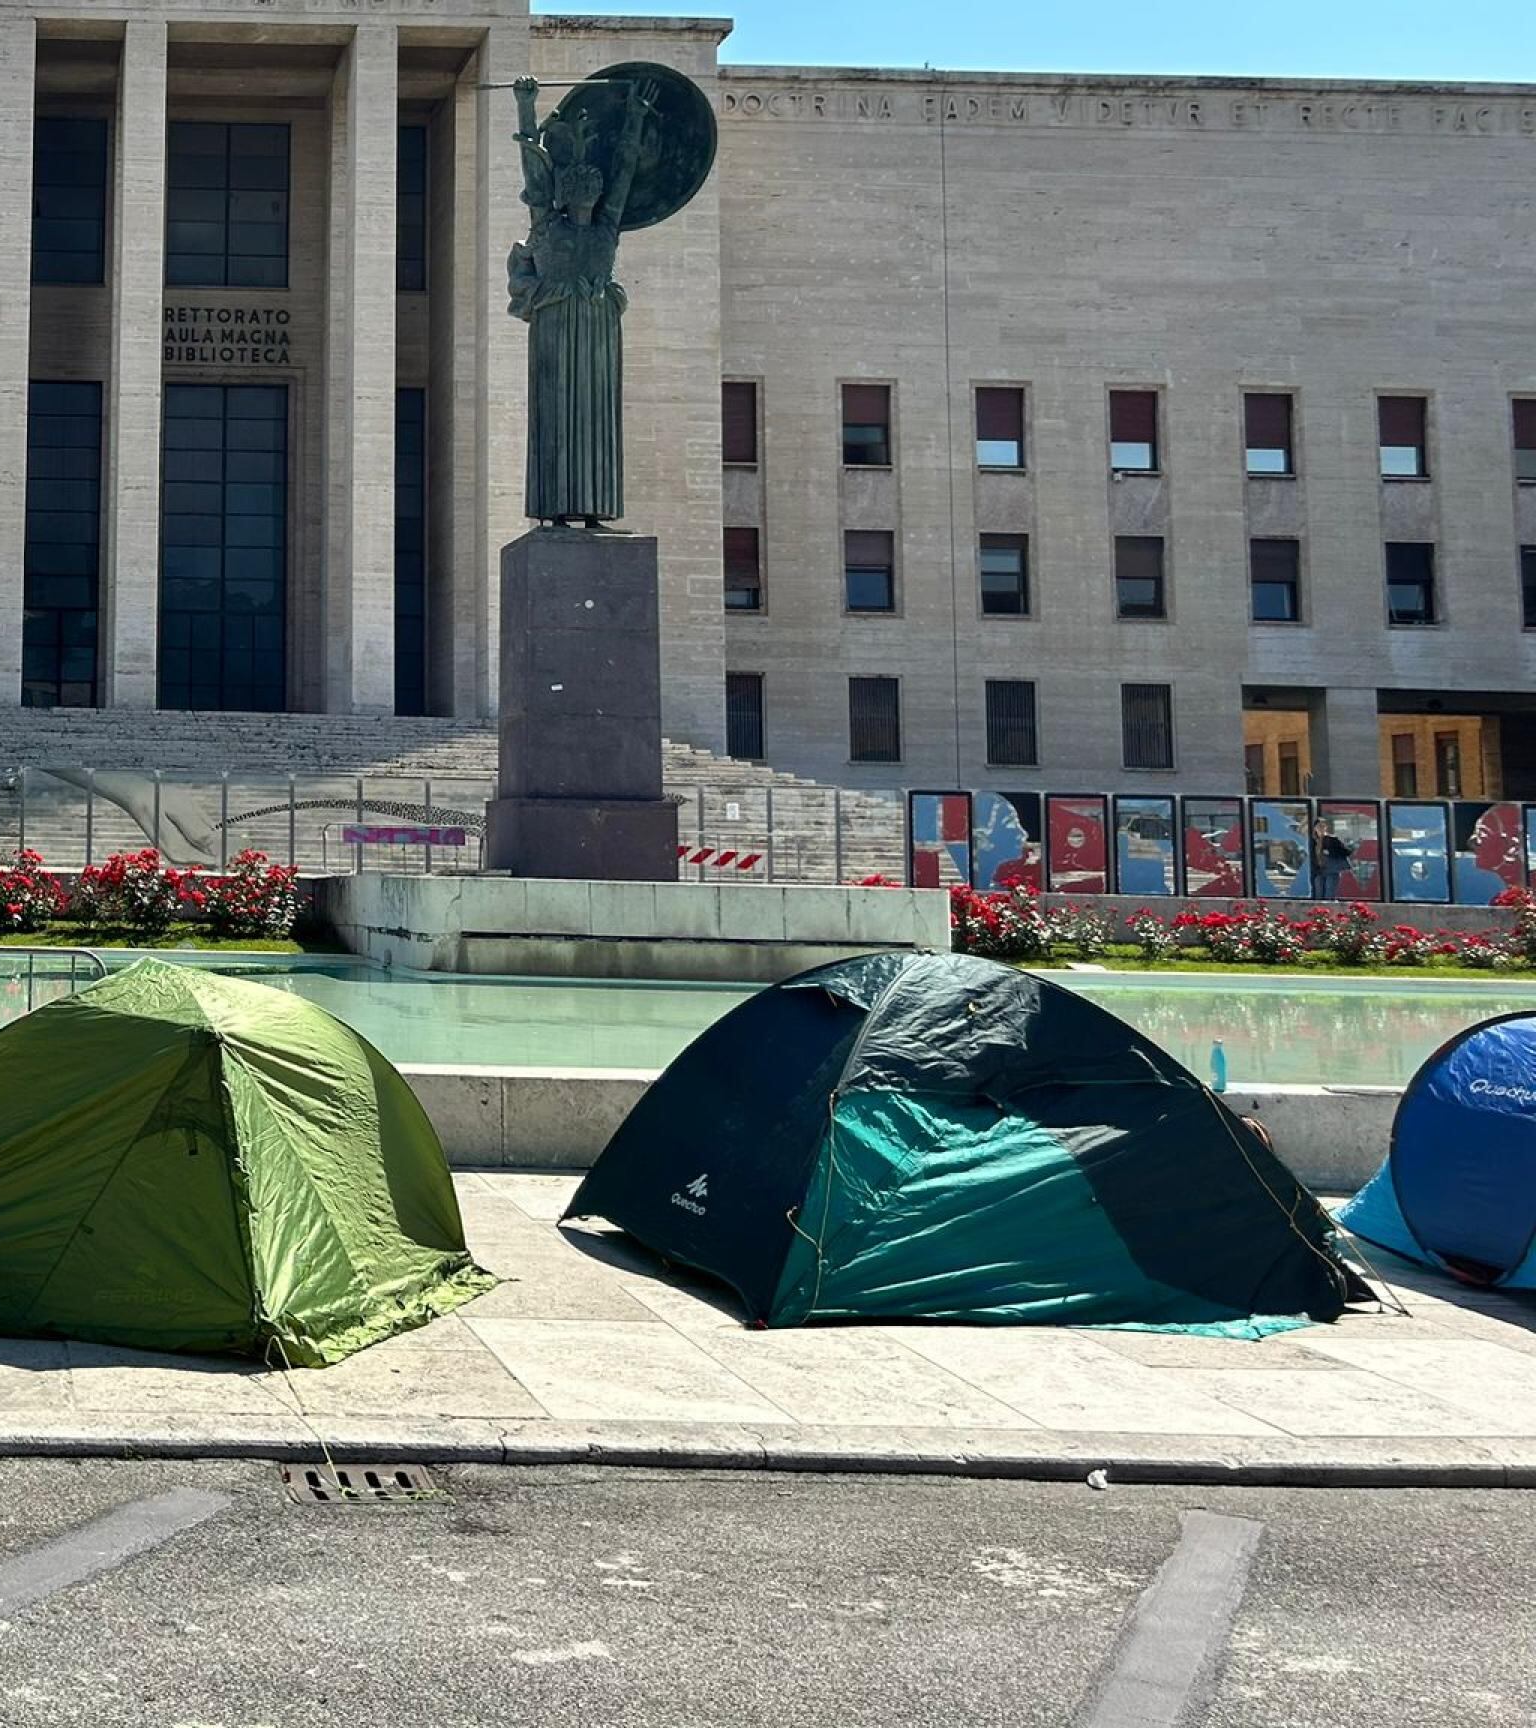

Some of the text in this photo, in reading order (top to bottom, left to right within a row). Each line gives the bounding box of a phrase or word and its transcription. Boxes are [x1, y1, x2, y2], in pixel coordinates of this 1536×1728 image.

[722, 90, 893, 118] DOCTRINA
[921, 96, 1028, 122] EADEM
[1054, 99, 1203, 126] VIDETVR
[1230, 103, 1269, 128] ET
[1298, 104, 1401, 129] RECTE
[164, 307, 291, 325] RETTORATO
[165, 328, 291, 345] AULA MAGNA
[164, 346, 291, 364] BIBLIOTECA
